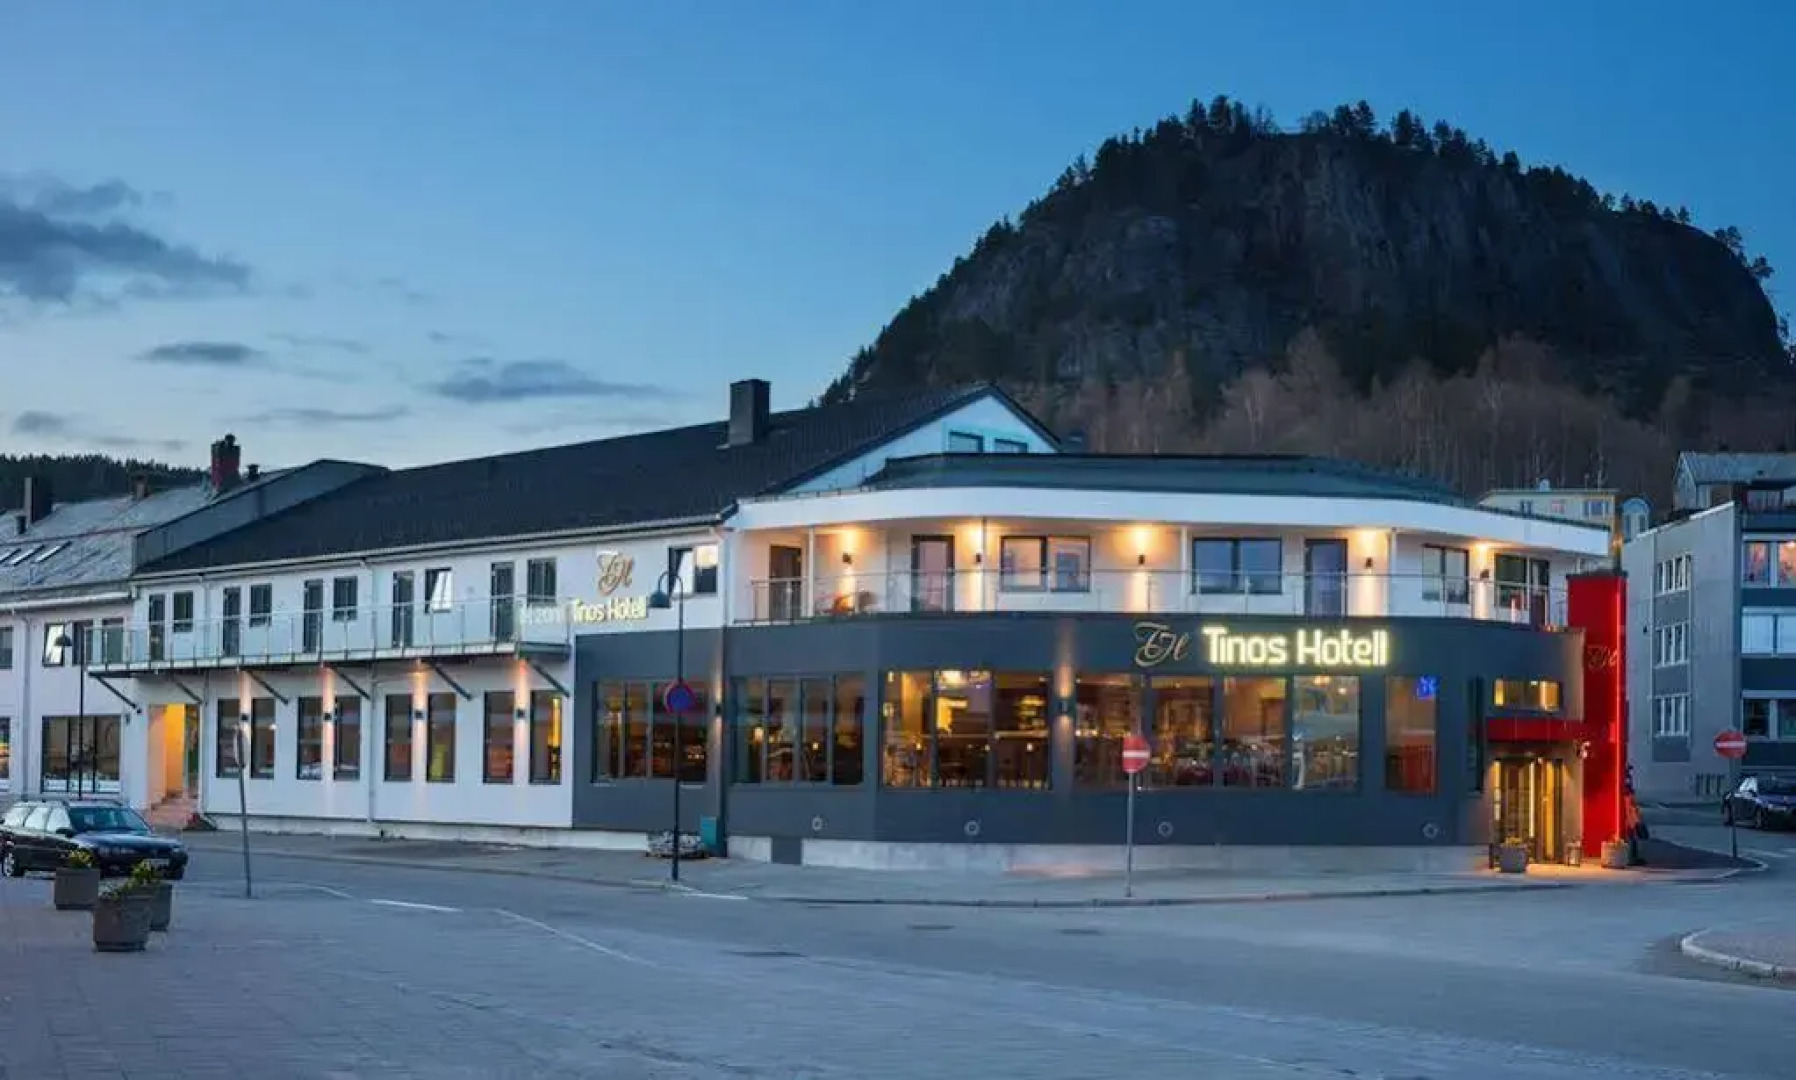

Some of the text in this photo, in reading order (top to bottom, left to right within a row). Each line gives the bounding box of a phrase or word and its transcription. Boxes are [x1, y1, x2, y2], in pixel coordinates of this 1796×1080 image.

[574, 598, 605, 623] Tinos
[1203, 625, 1287, 665] Tinos
[1297, 628, 1389, 667] Hotell
